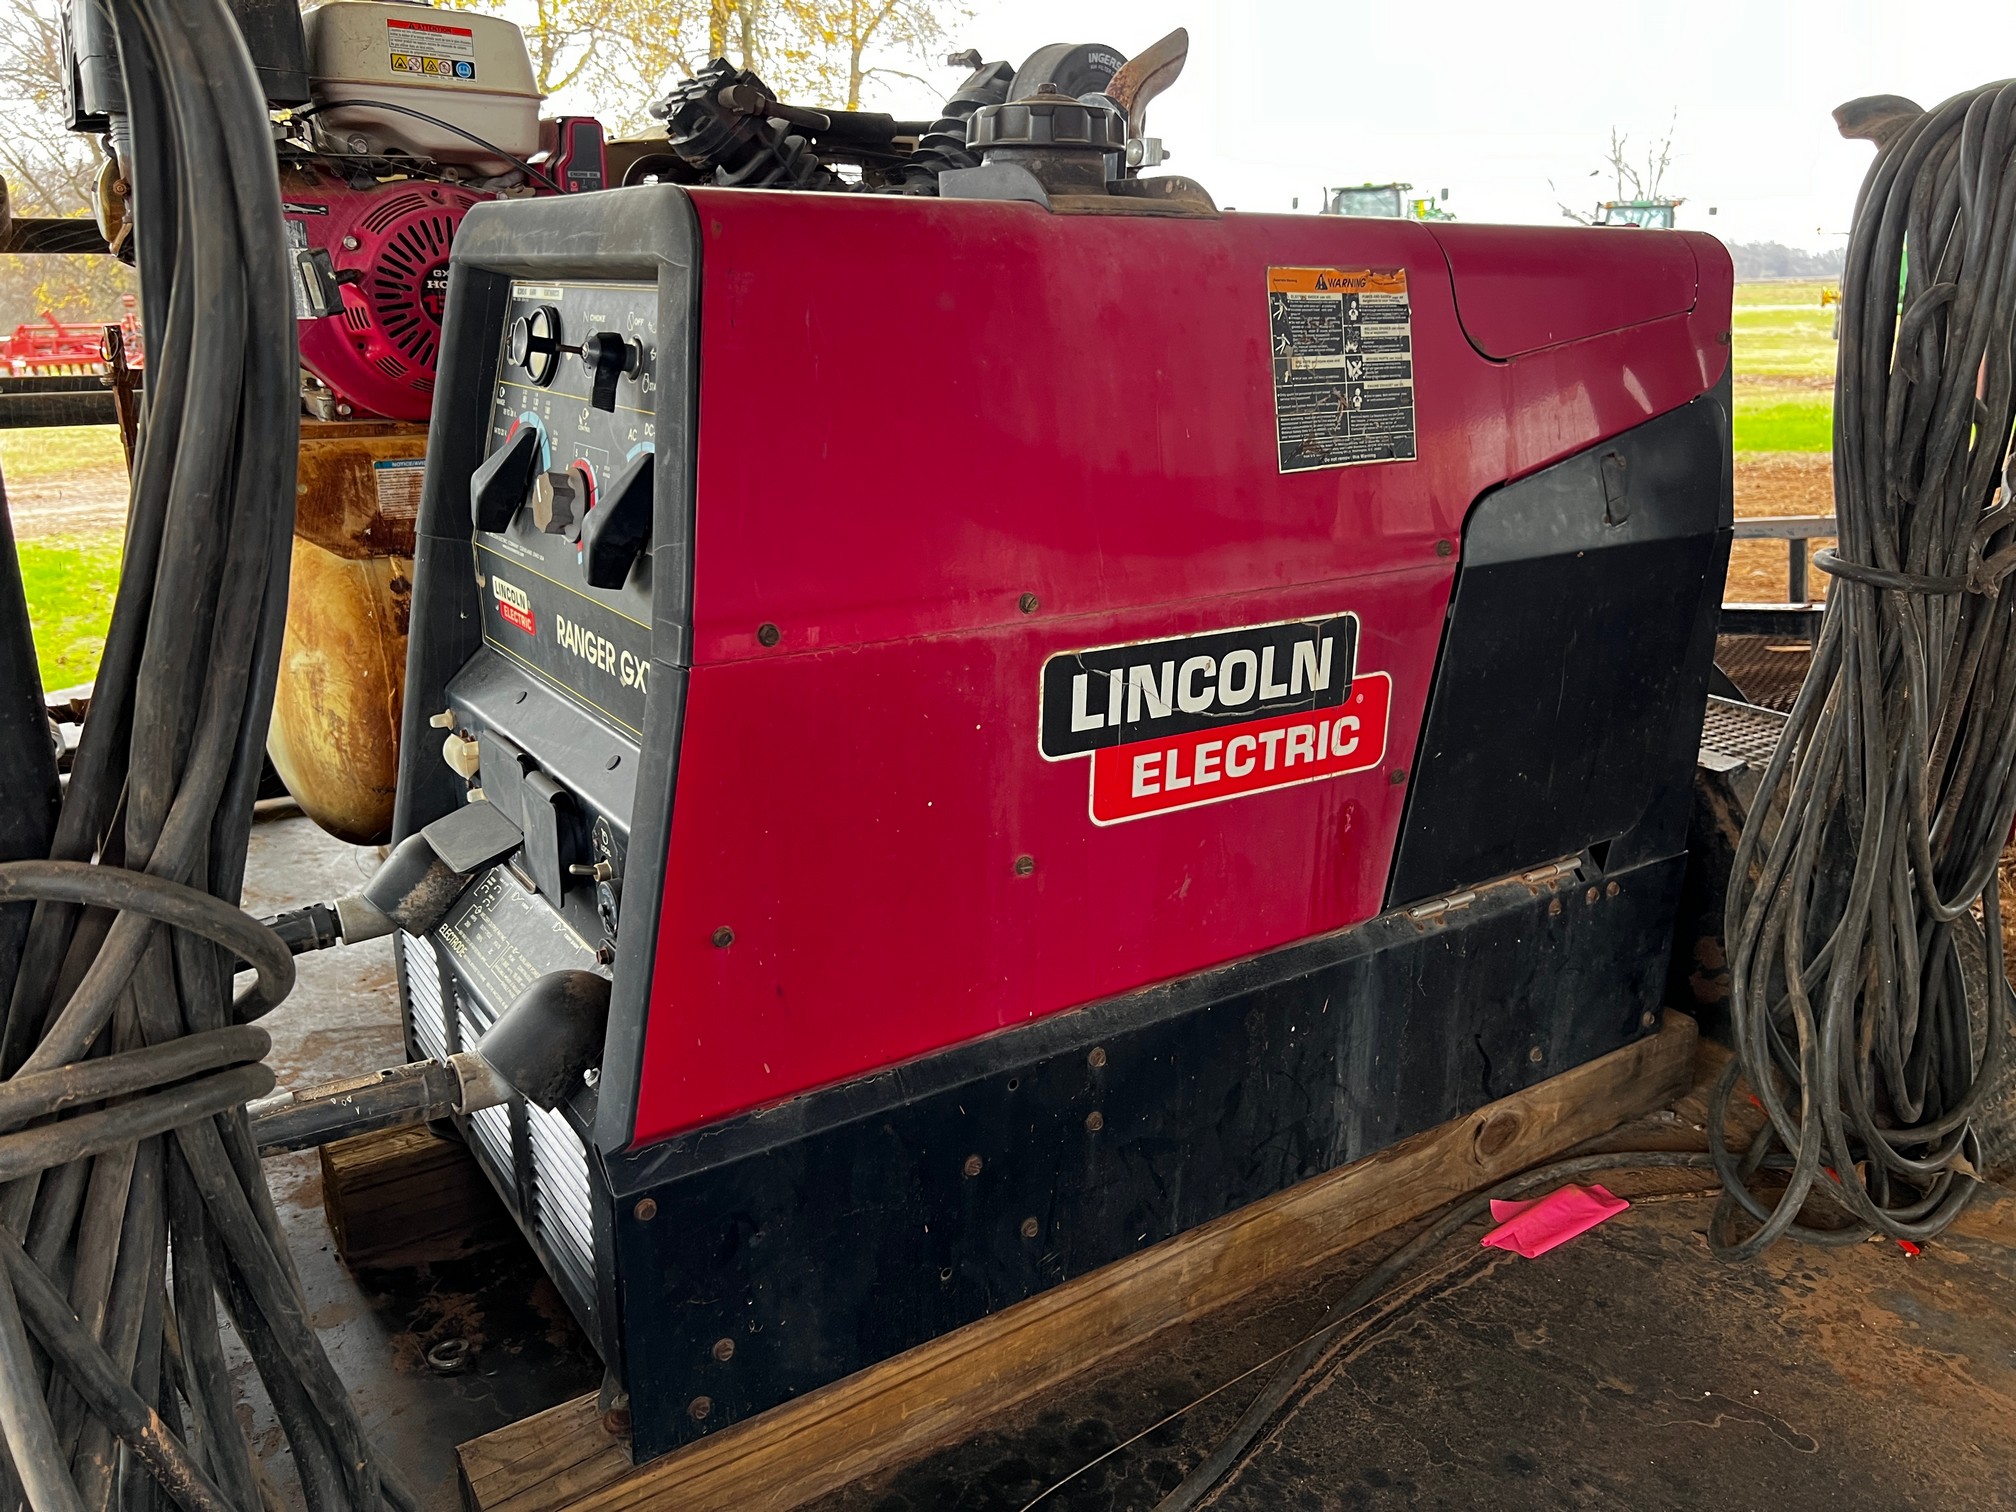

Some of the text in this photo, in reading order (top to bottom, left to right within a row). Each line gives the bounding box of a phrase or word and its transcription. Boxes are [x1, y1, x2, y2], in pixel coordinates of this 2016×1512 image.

[1088, 53, 1122, 71] INGERS
[426, 280, 448, 289] HO
[1327, 278, 1367, 288] WARNING
[590, 314, 606, 323] CHOKE
[634, 318, 645, 326] OFF
[648, 382, 657, 392] STA
[627, 428, 638, 442] AC
[494, 580, 526, 610] LINCOLN
[503, 605, 532, 631] ELECTRIC
[556, 614, 616, 676] RANGER
[1071, 636, 1334, 733] LINCOLN
[1131, 715, 1361, 798] ELECTRIC
[438, 922, 468, 958] ELECTRODE
